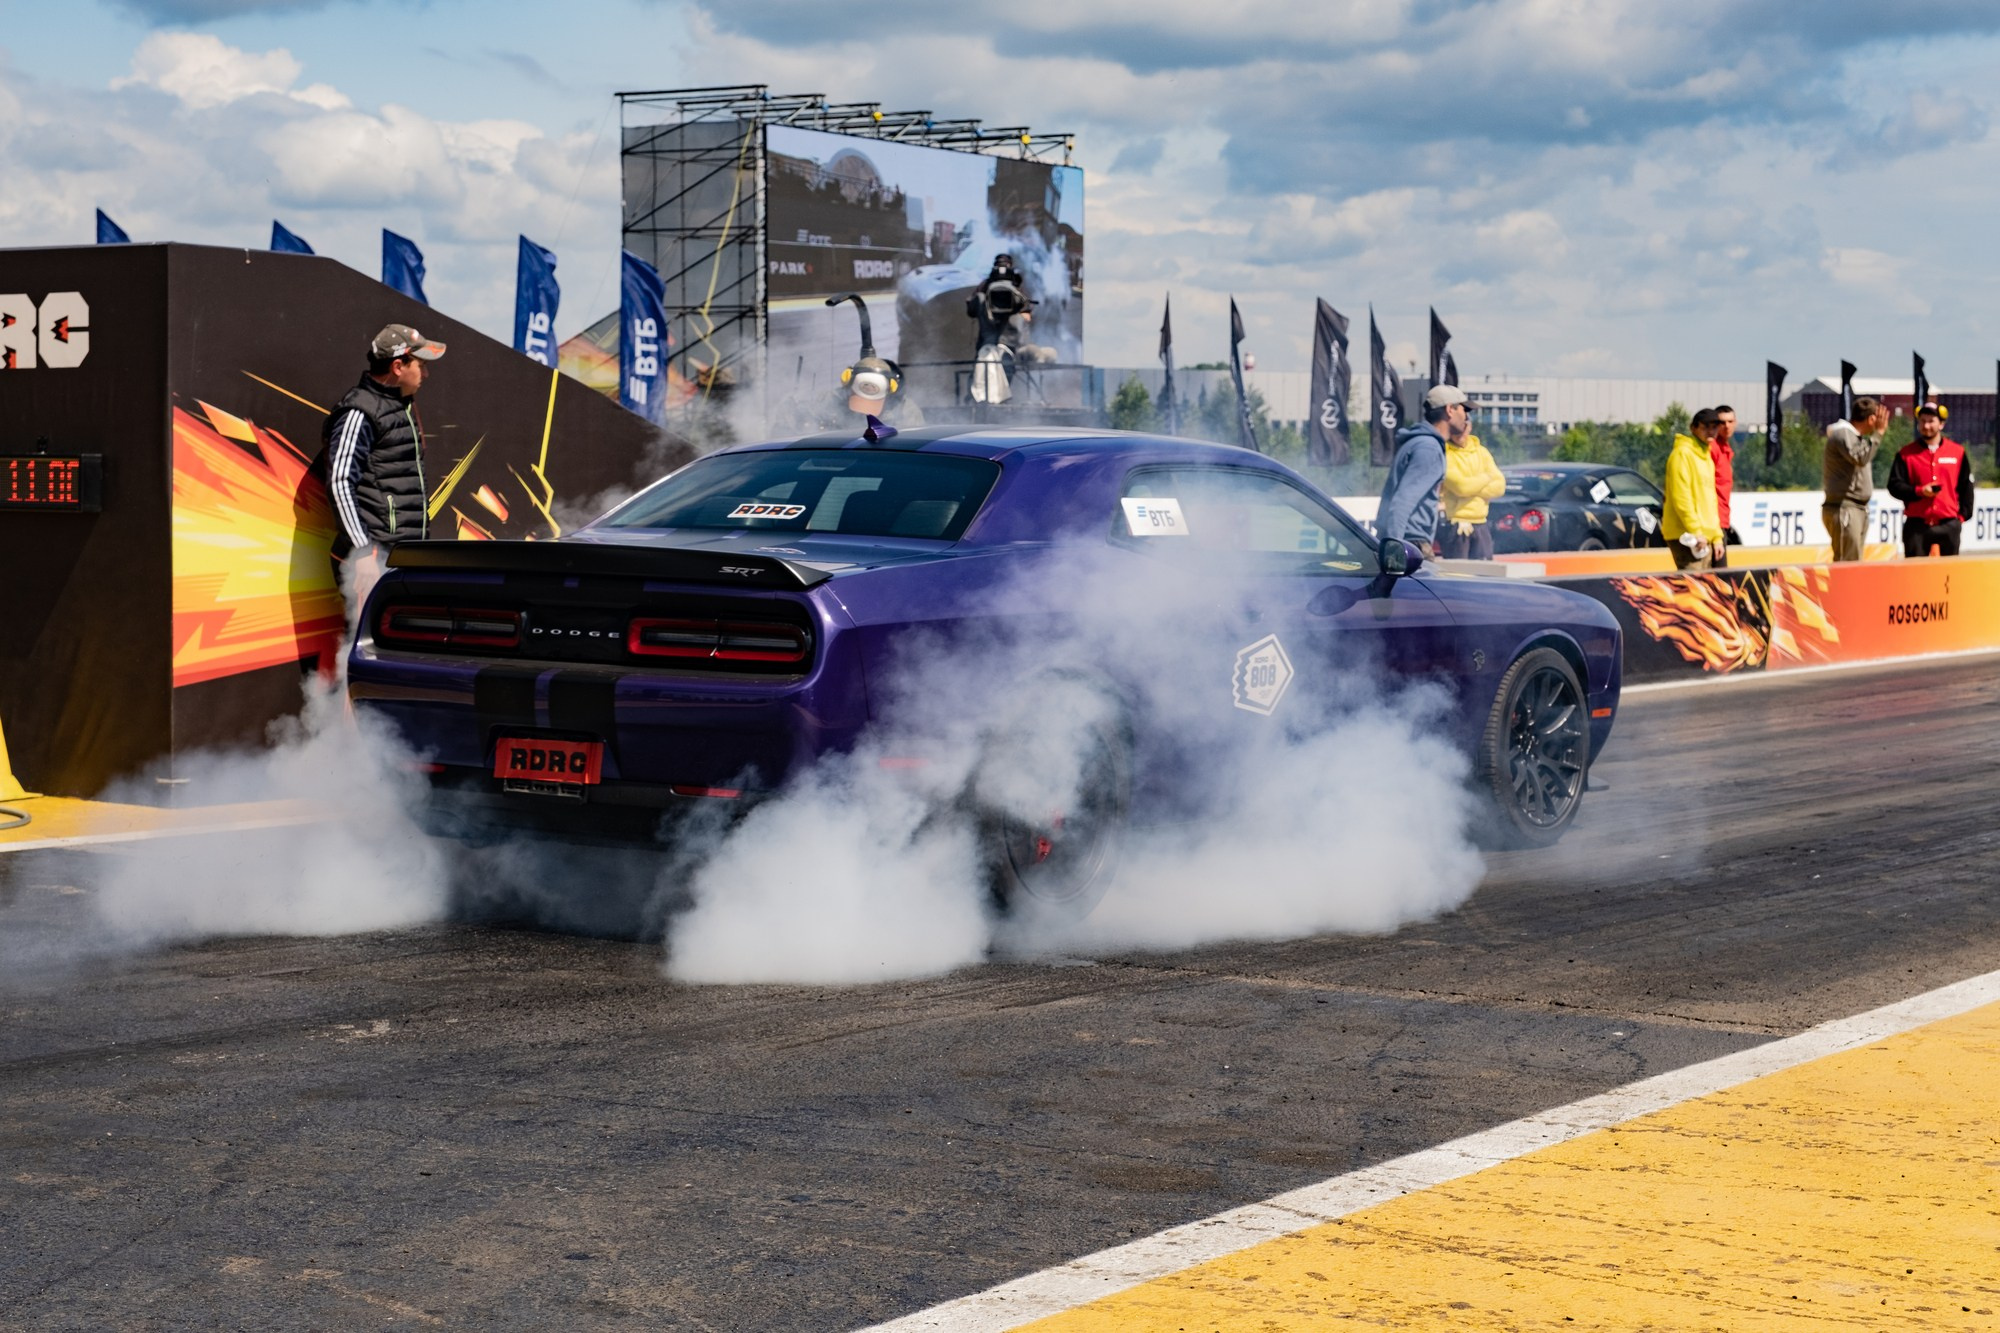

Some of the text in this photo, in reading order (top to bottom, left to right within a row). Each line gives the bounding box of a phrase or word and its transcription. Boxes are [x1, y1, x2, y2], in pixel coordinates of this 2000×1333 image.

[769, 260, 807, 275] PARK
[634, 317, 658, 376] ВТБ
[735, 505, 802, 516] RDRC
[1148, 510, 1175, 527] ВТБ
[1770, 511, 1805, 545] ВТБ
[1880, 509, 1905, 543] ВТ
[718, 566, 765, 577] SRT
[1888, 601, 1949, 625] ROSGONKI
[532, 627, 620, 639] DODGE
[1251, 664, 1277, 688] 808
[510, 748, 587, 773] RDRC
